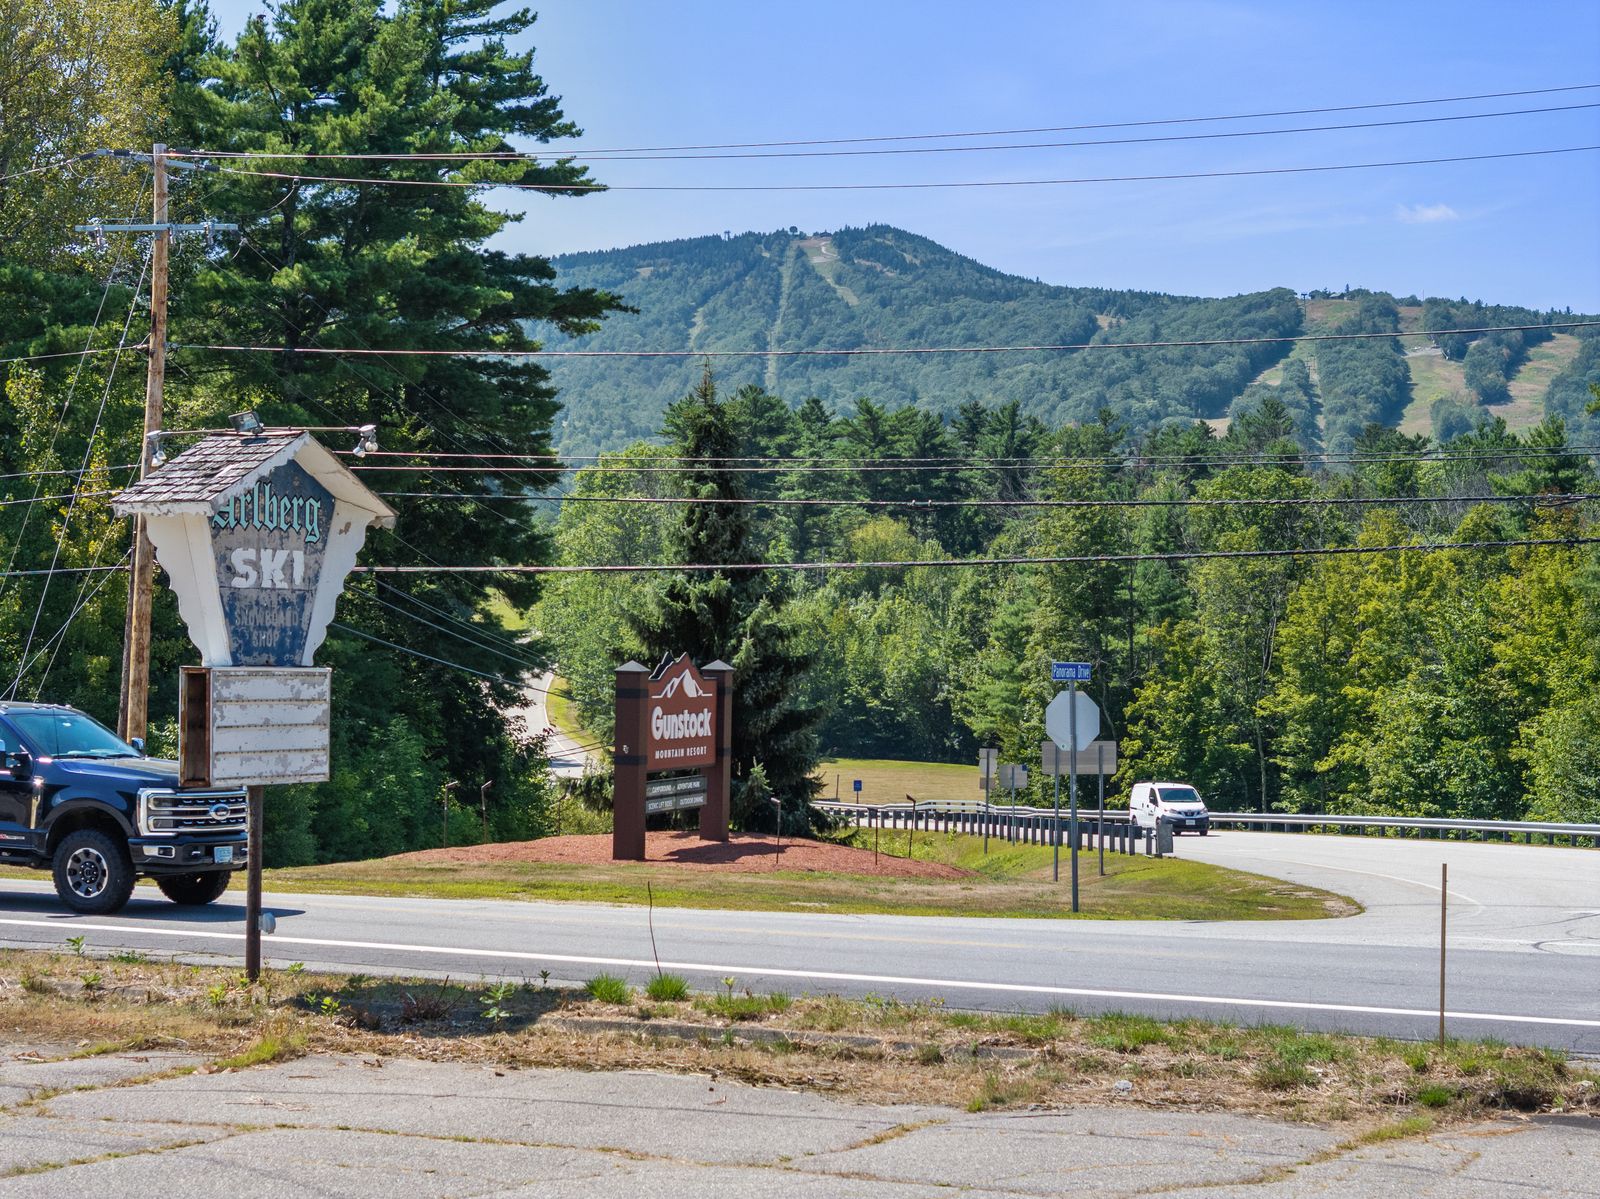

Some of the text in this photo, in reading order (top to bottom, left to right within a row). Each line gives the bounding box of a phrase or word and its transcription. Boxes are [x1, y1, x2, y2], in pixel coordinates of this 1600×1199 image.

[211, 481, 321, 544] Arlberg
[231, 548, 304, 588] SKI
[252, 629, 280, 648] SHOP
[1053, 664, 1090, 678] Panorama Drive
[651, 706, 712, 740] Gunstock
[655, 746, 707, 759] MOUNTAIN RESORT
